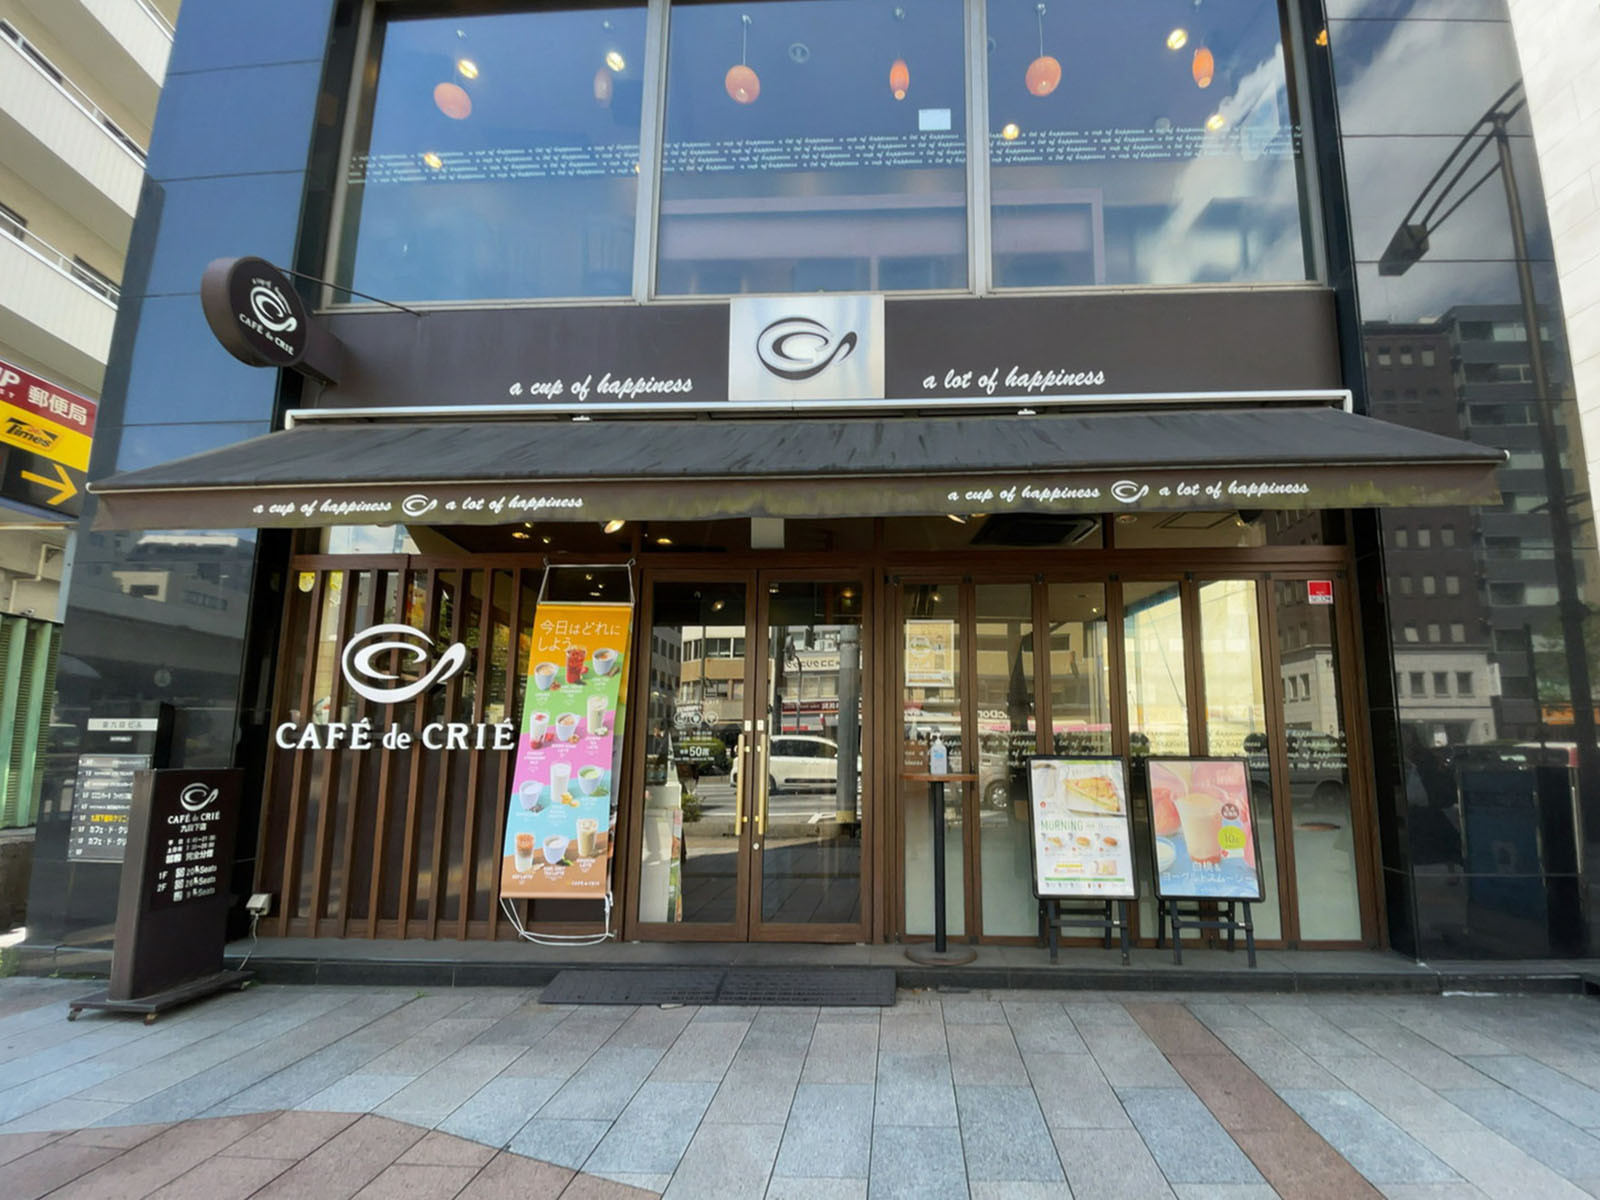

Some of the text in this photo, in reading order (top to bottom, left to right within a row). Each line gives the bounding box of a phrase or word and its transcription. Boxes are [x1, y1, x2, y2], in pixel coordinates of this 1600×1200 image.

[509, 372, 694, 401] a cup of happiness
[922, 365, 1106, 395] a lot of happiness
[28, 385, 88, 427] 郵便局
[5, 417, 54, 448] Times
[947, 485, 1101, 503] a cup of happiness
[1158, 479, 1311, 499] a lot of happiness
[252, 499, 392, 518] a cup of happiness
[445, 494, 584, 515] a lot of happiness
[540, 619, 621, 636] 今日はどれに
[382, 722, 411, 749] de
